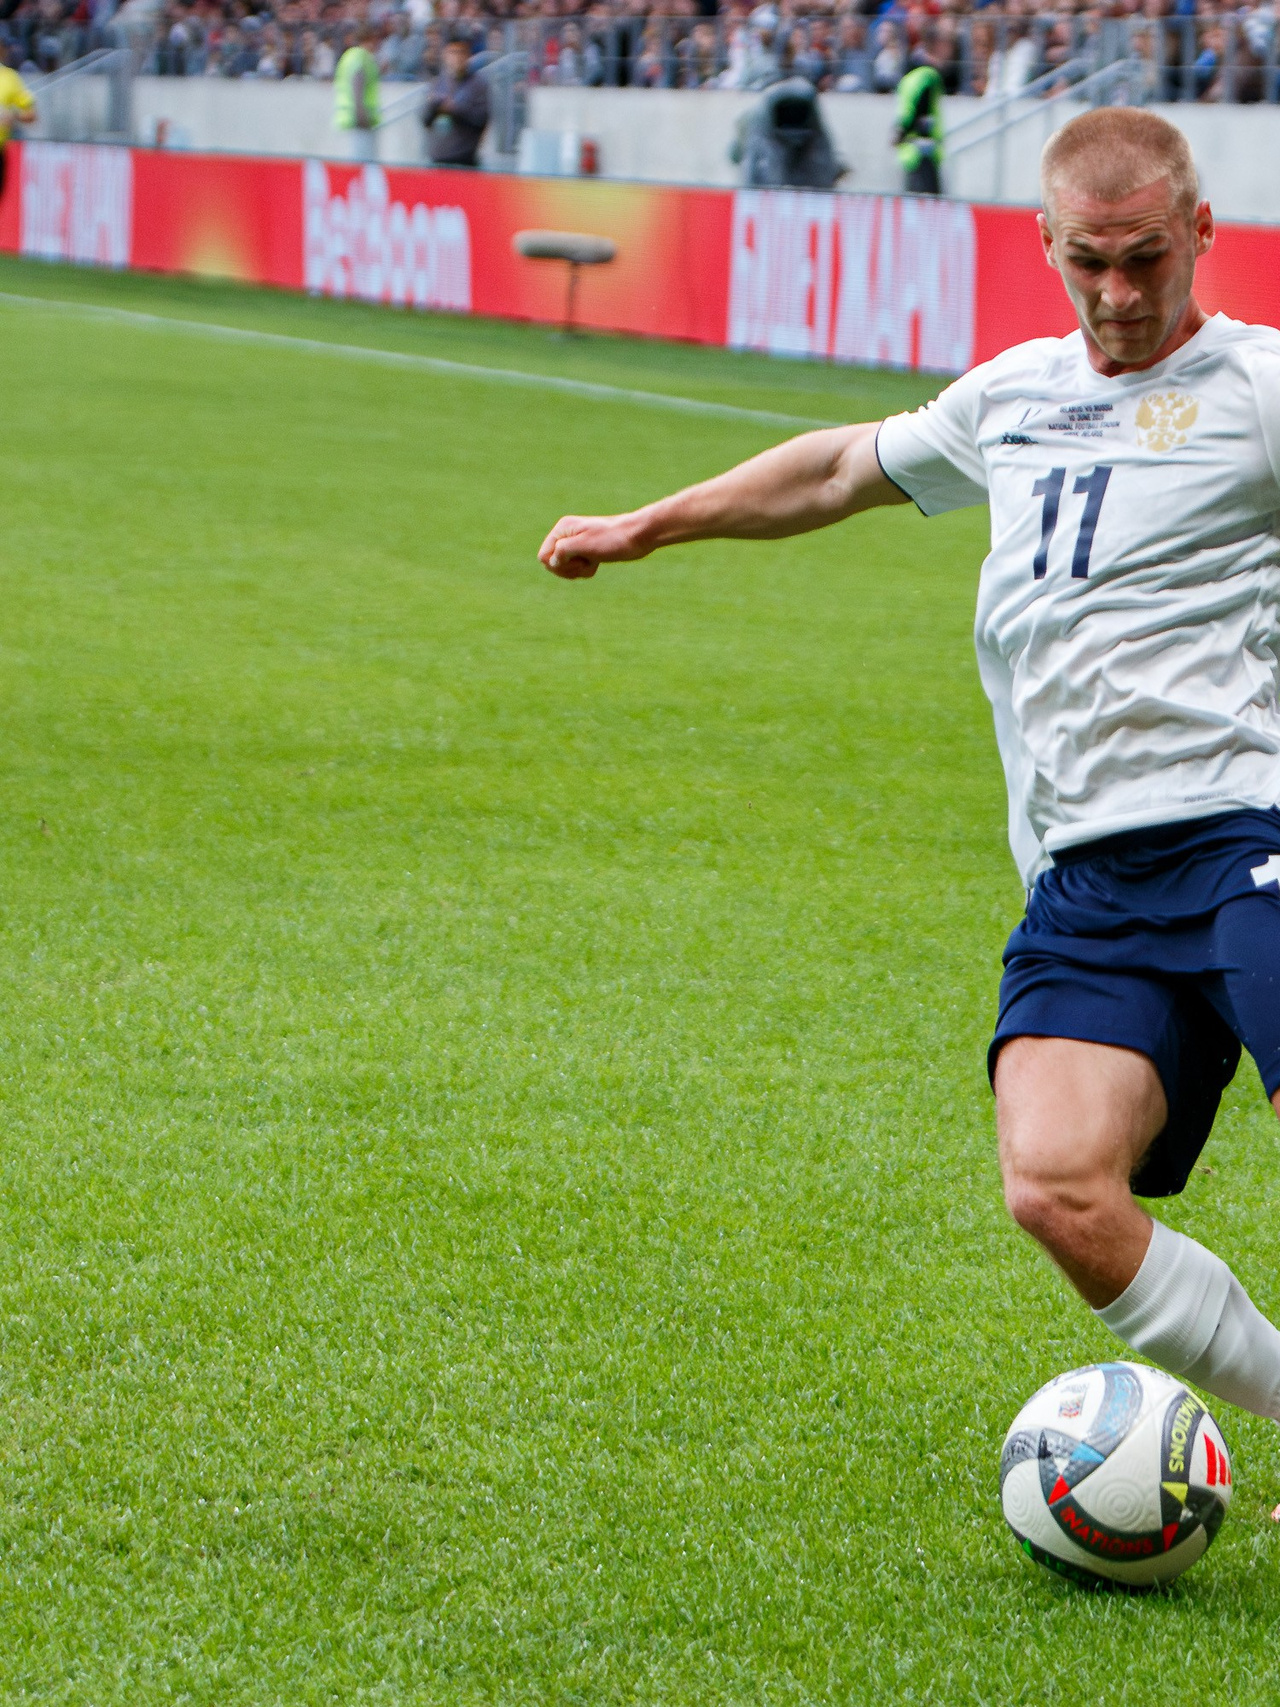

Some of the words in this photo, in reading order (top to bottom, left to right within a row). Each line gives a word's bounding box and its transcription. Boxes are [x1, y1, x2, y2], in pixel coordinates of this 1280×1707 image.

[303, 158, 471, 311] BetBoom
[1032, 465, 1113, 579] 11
[1168, 1396, 1199, 1473] NATIONS
[1060, 1506, 1154, 1554] NATIONS
